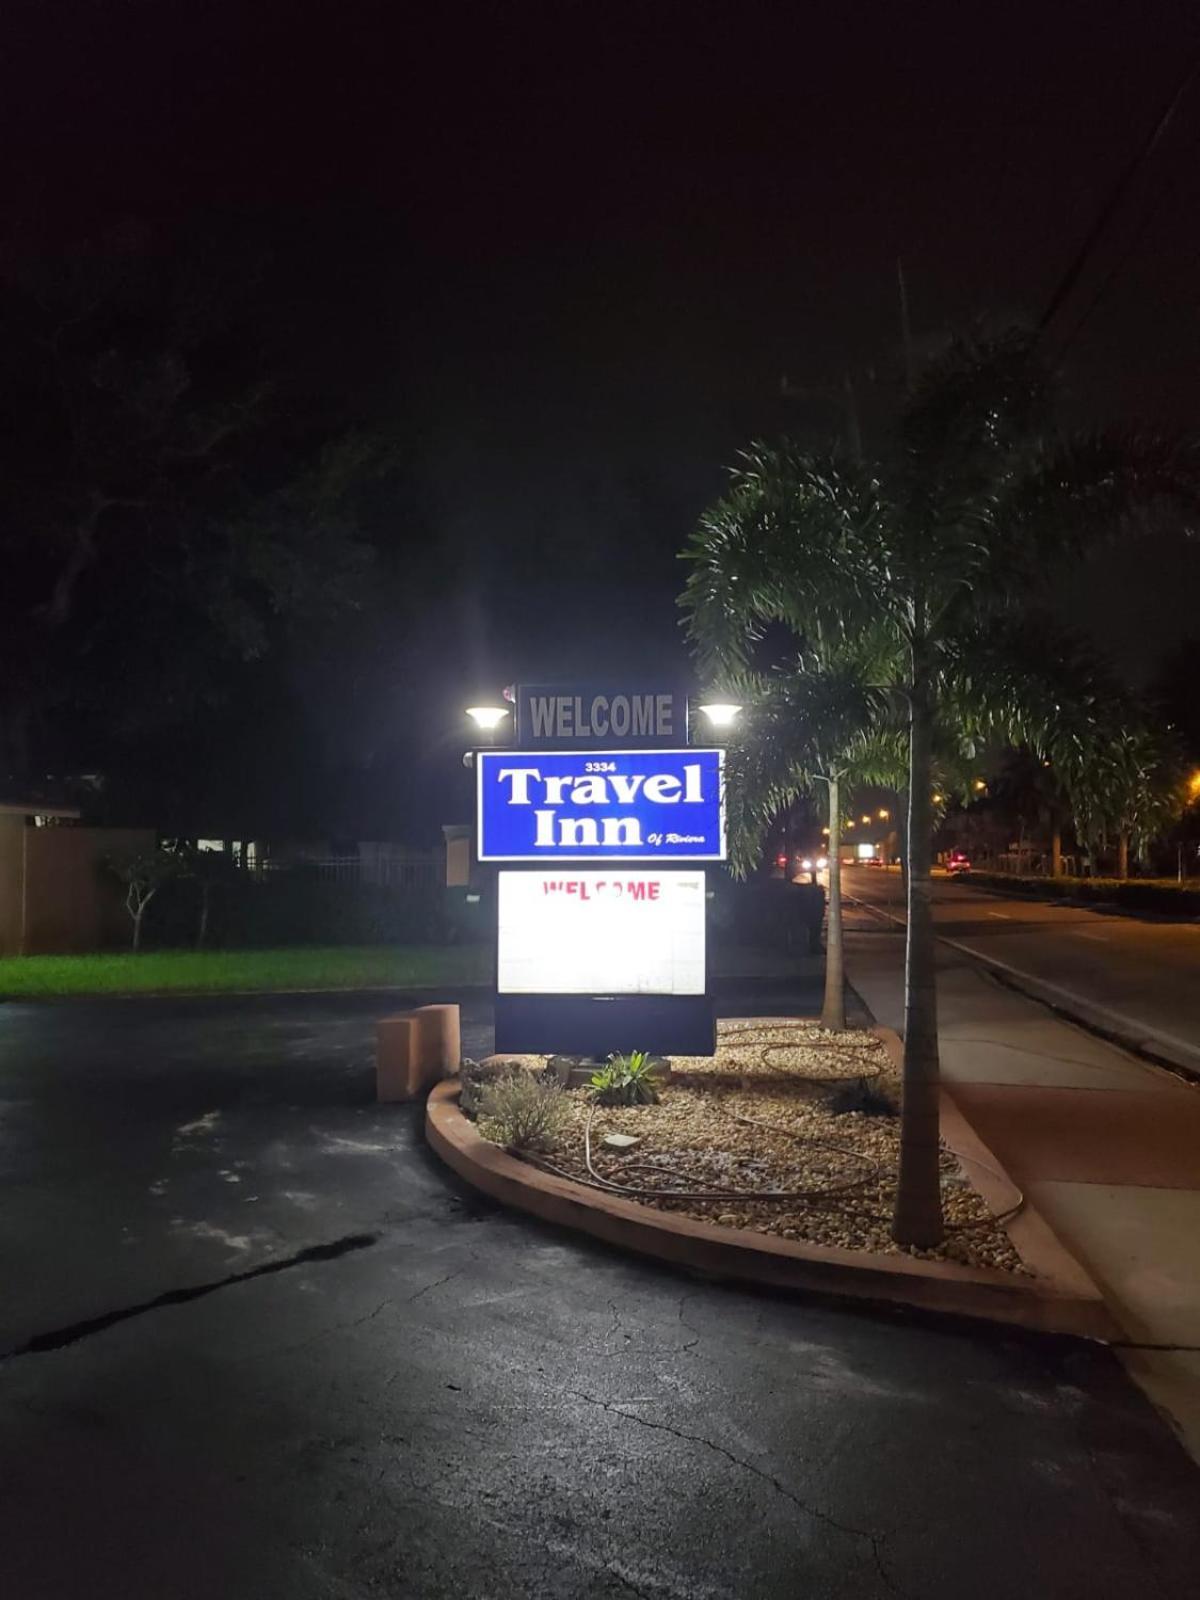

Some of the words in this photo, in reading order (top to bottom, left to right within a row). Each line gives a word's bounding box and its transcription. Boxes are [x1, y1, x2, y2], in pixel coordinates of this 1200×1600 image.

[529, 695, 673, 737] WELCOME
[498, 764, 704, 804] Travel
[585, 762, 617, 772] 3334
[534, 810, 643, 846] Inn
[647, 833, 663, 846] Of
